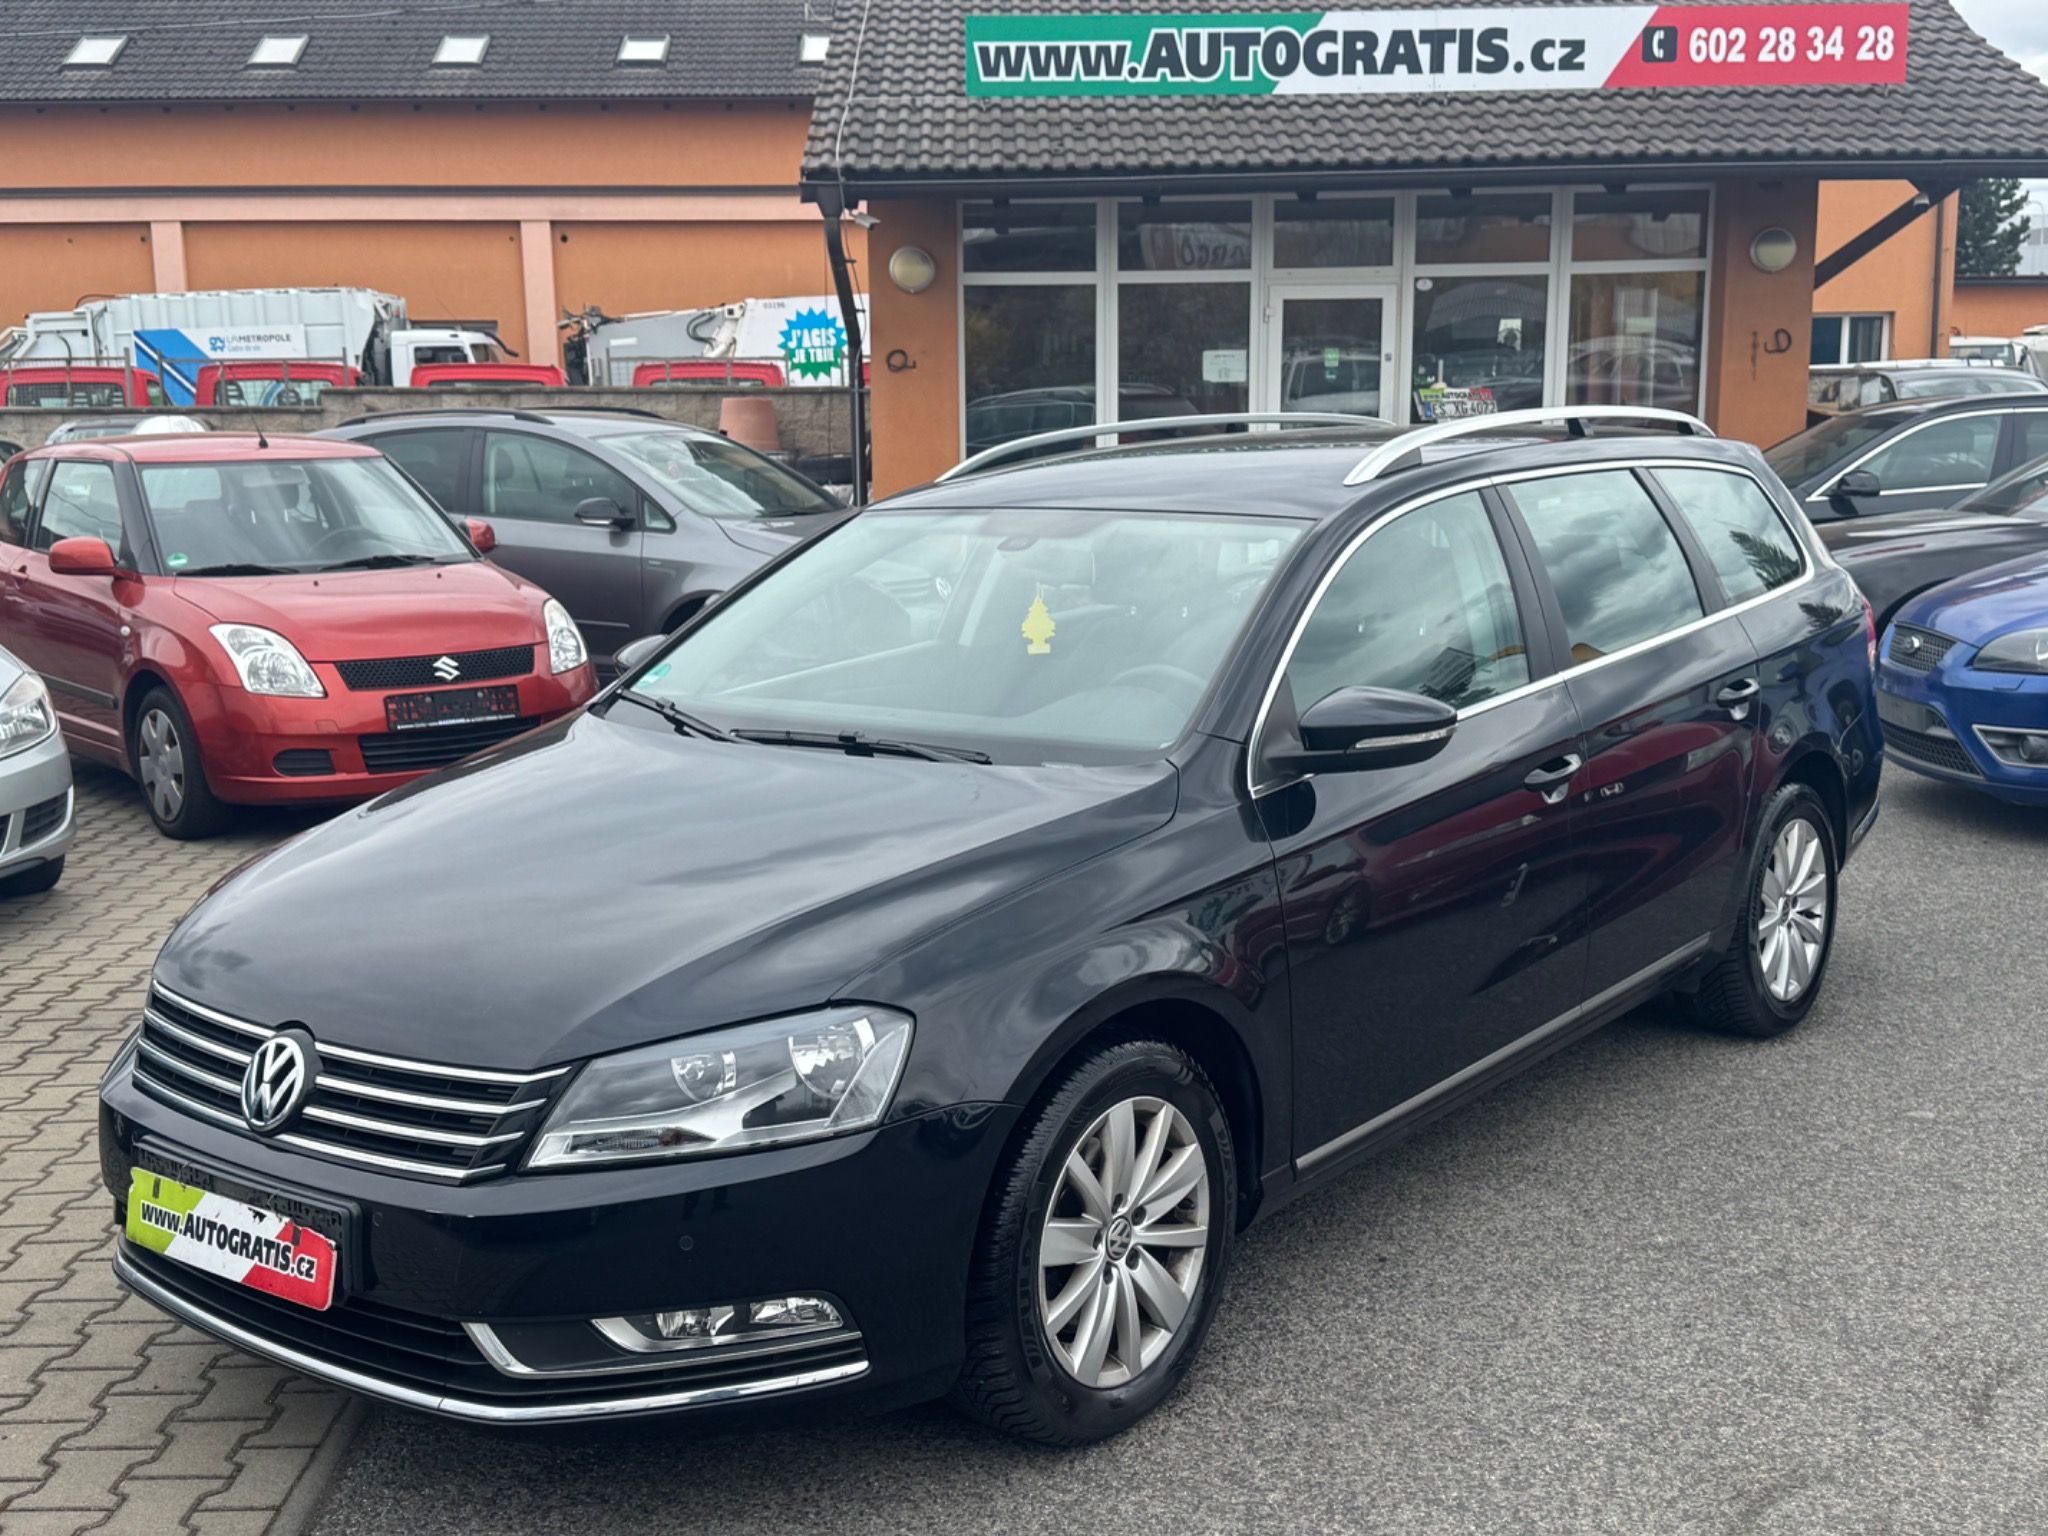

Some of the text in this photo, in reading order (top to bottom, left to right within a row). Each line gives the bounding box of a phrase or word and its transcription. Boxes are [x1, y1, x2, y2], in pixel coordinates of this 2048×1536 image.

[976, 25, 1895, 81] www.AUTOGRATIS.cz 602 28 34 28
[787, 327, 837, 349] J'AGIS
[792, 348, 807, 364] JE
[140, 1202, 317, 1280] www.AUTOGRATIS.cz
